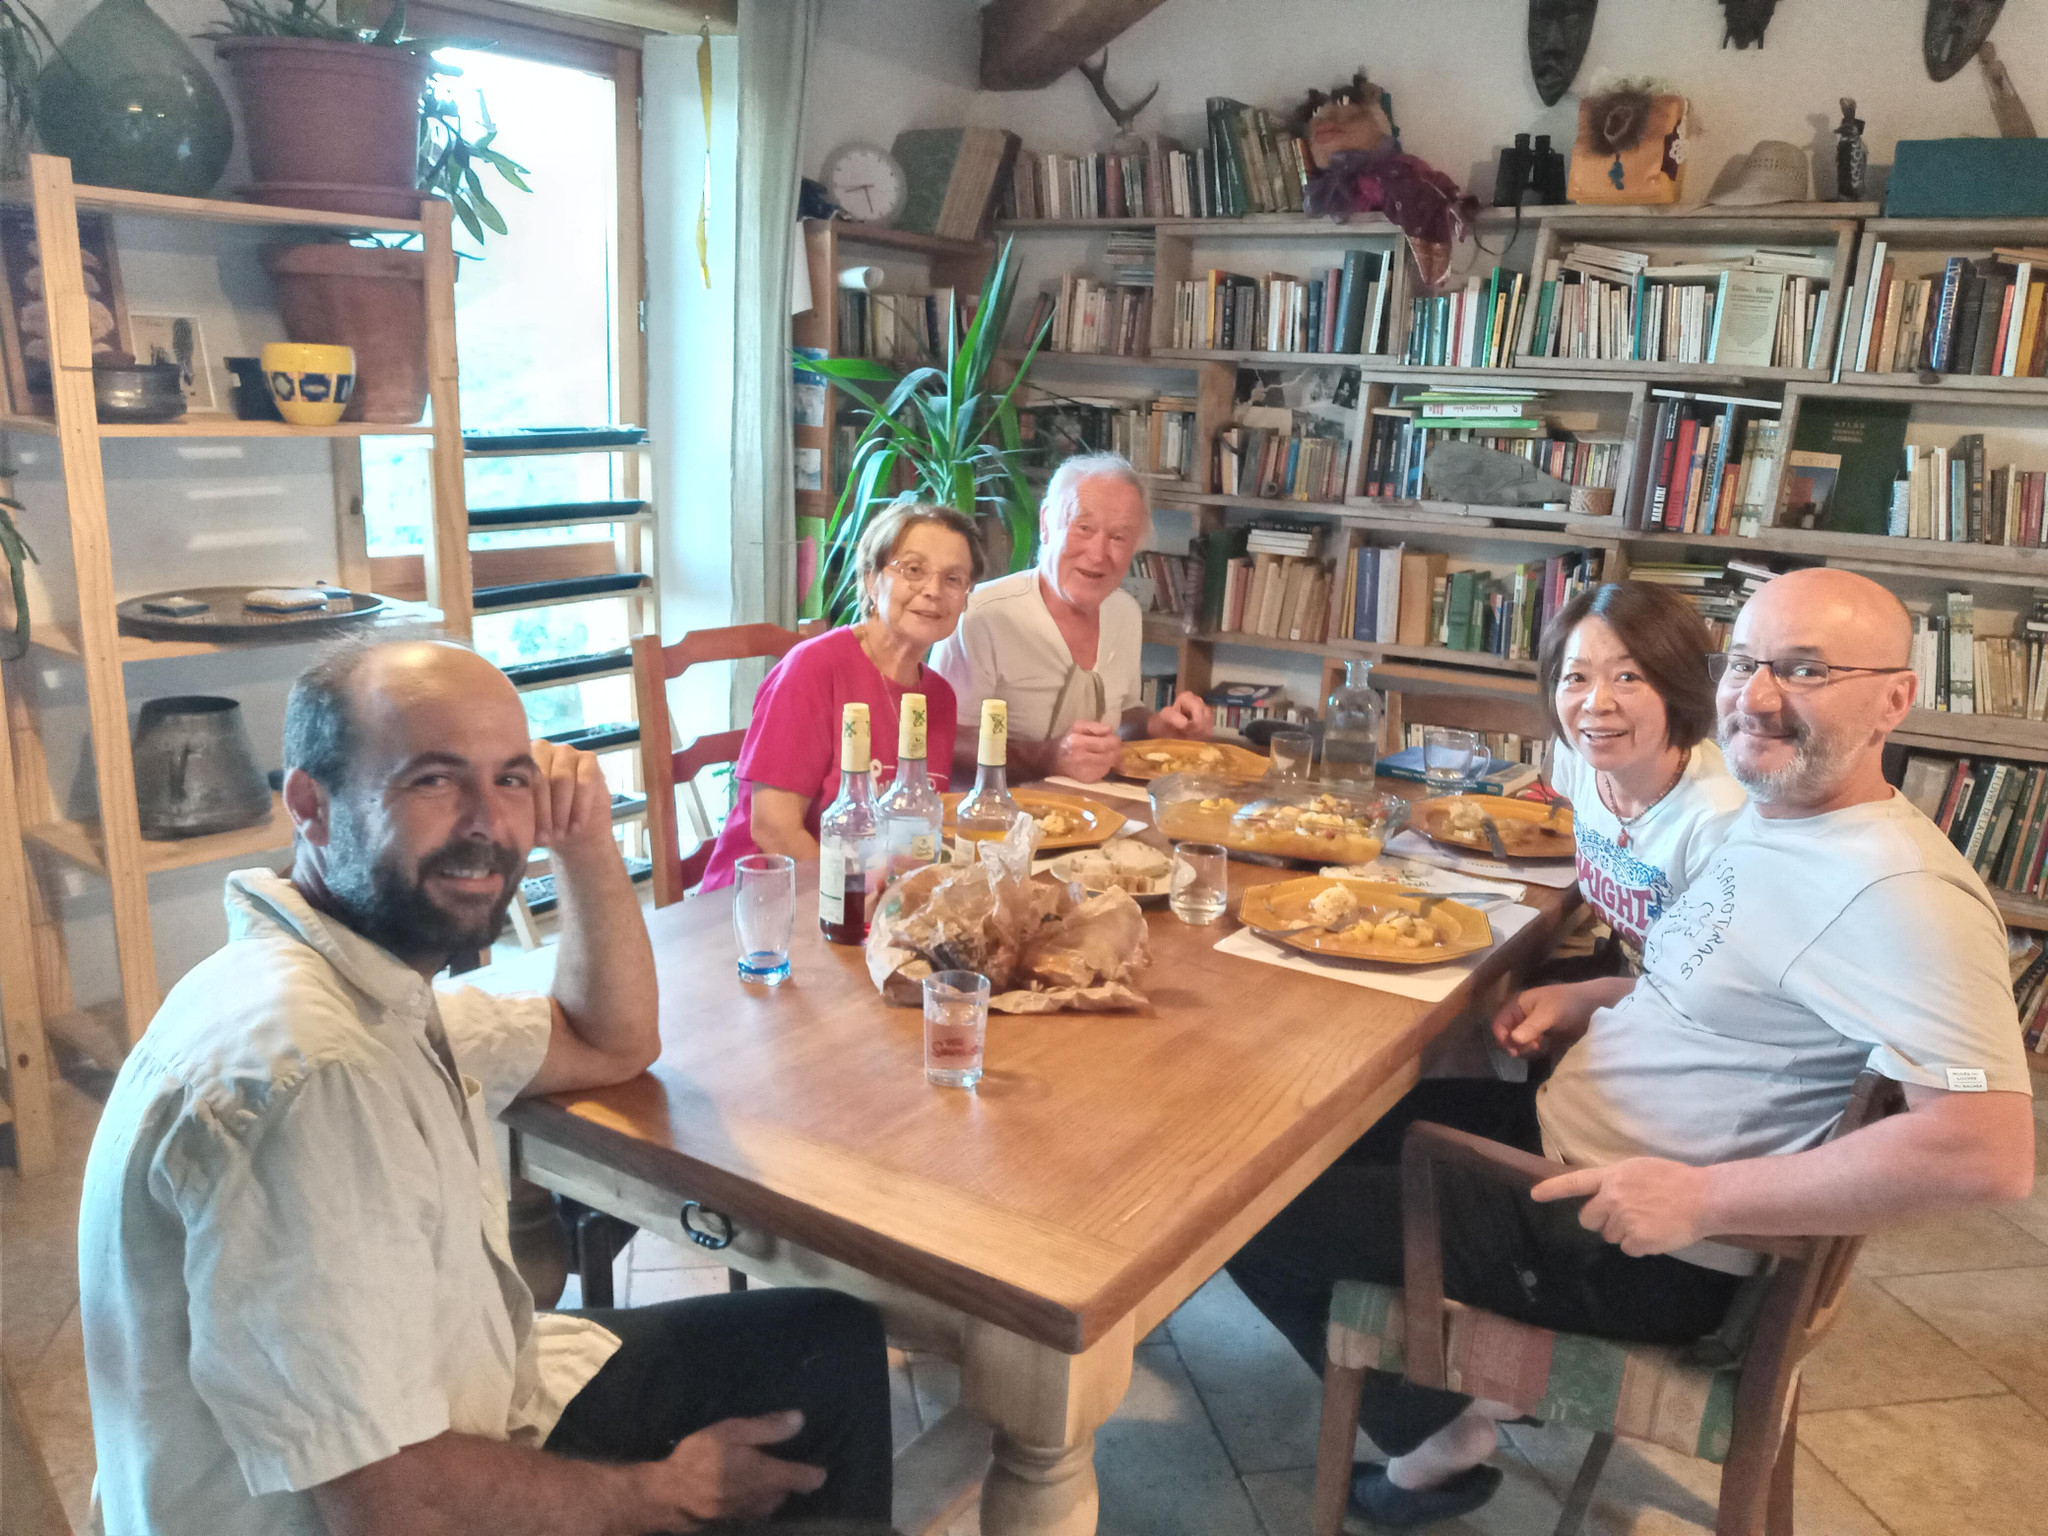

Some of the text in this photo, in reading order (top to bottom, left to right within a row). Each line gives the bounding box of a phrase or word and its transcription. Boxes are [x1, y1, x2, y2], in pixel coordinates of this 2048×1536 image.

[1985, 782, 2001, 805] LIVRE
[1981, 806, 1991, 817] DE
[1975, 819, 1987, 832] LA
[1680, 866, 1736, 981] SAMOTHRACE
